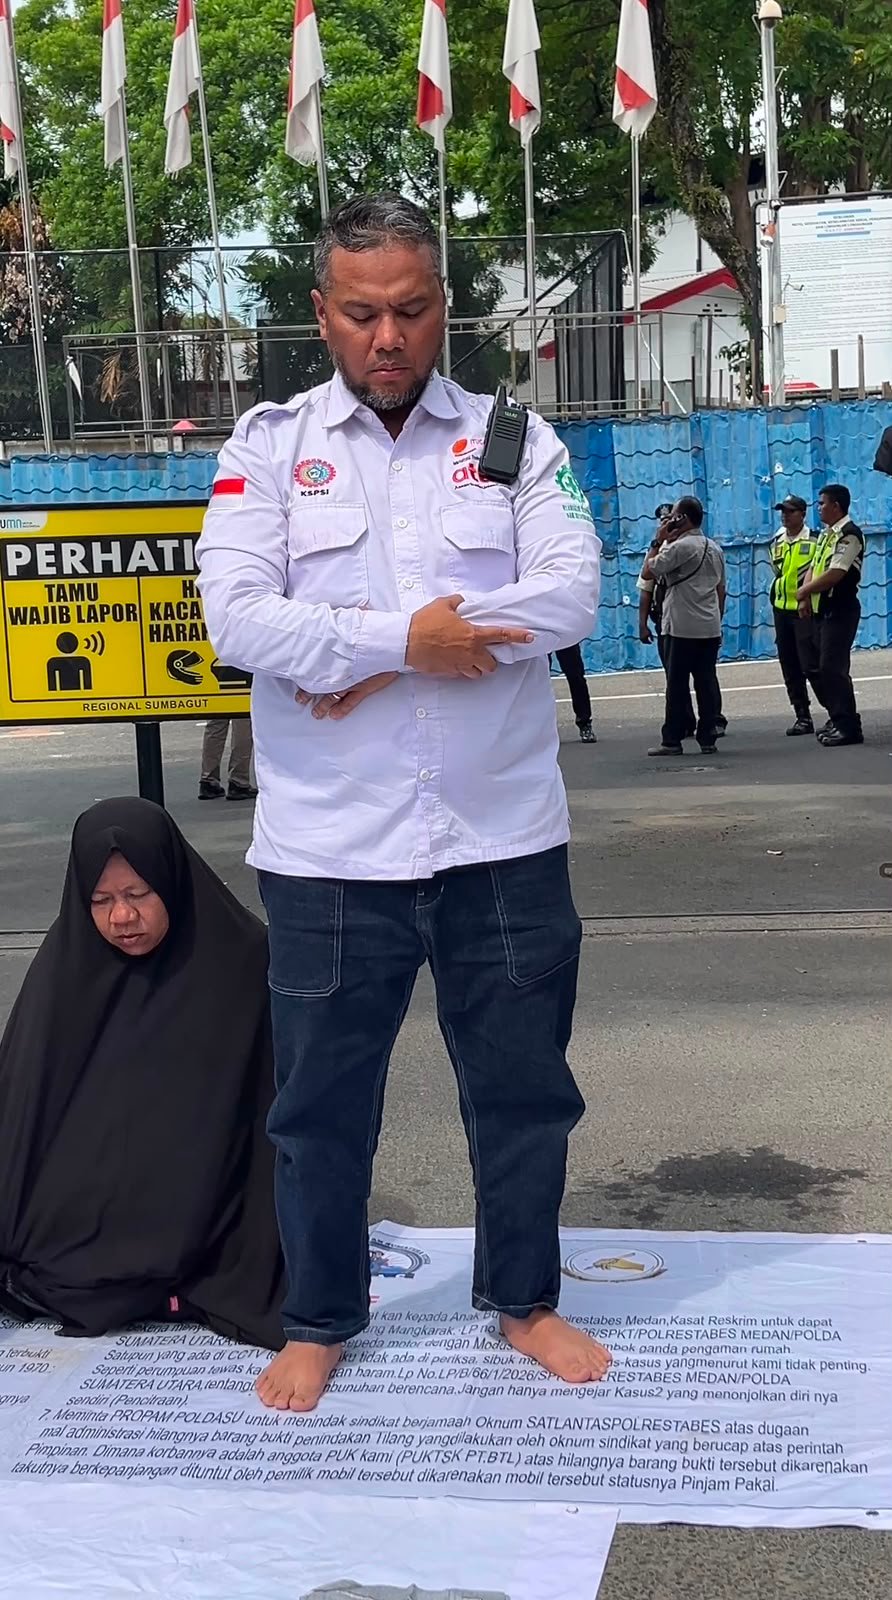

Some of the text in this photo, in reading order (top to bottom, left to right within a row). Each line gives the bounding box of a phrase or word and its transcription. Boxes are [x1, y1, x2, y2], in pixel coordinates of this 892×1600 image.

[301, 489, 329, 497] KSPSI
[6, 539, 198, 577] PERHATI
[44, 582, 99, 602] TAMU
[8, 602, 138, 626] WAJIB LAPOR
[149, 601, 202, 621] KACA
[83, 699, 209, 712] REGIONAL SUMBAGUT
[405, 1311, 447, 1323] kepada
[450, 1311, 479, 1322] Anak
[708, 1315, 758, 1327] Reskrim
[761, 1316, 794, 1327] untuk
[798, 1317, 833, 1329] dapat
[480, 1324, 496, 1333] no
[740, 1330, 842, 1342] MEDAN/POLDA
[6, 1348, 53, 1359] terbukti
[116, 1334, 187, 1348] SUMATERA
[388, 1339, 422, 1349] motor
[425, 1338, 470, 1351] dengan
[472, 1337, 514, 1351] Modus
[639, 1344, 678, 1354] ganda
[681, 1344, 747, 1356] pengaman
[104, 1349, 154, 1362] Satupun
[153, 1350, 186, 1363] yang
[187, 1351, 212, 1361] ada
[213, 1350, 225, 1361] di
[228, 1349, 265, 1361] CCTV
[360, 1351, 387, 1363] tidak
[391, 1353, 414, 1363] ada
[417, 1352, 429, 1363] di
[483, 1354, 516, 1366] sibuk
[751, 1358, 782, 1370] kami
[785, 1359, 816, 1371] tidak
[819, 1360, 871, 1374] penting.
[92, 1363, 137, 1377] Seperti
[136, 1364, 205, 1378] perumpuan
[207, 1362, 245, 1374] tewas
[685, 1372, 791, 1385] MEDAN/POLDA
[66, 1394, 109, 1406] sendiri
[80, 1378, 154, 1390] SUMATERA
[507, 1385, 547, 1398] hanya
[550, 1386, 611, 1399] mengejar
[614, 1387, 663, 1398] Kasus2
[665, 1388, 698, 1401] yang
[702, 1389, 786, 1403] menonjolkan
[789, 1390, 811, 1402] diri
[814, 1392, 839, 1405] nya
[38, 1408, 809, 1438] 7. Meminta PROPAM POLDASU untuk menindak sindikat berjamaah Oknum SATLANTASPOLRESTABES atas dugaan
[39, 1425, 64, 1438] mal
[65, 1425, 145, 1440] administrasi
[145, 1427, 209, 1445] hilangnya
[211, 1428, 258, 1446] barang
[259, 1431, 294, 1445] bukti
[293, 1431, 371, 1447] penindakan
[376, 1431, 415, 1447] Tilang
[516, 1433, 545, 1447] oleh
[549, 1434, 595, 1448] oknum
[598, 1434, 651, 1450] sindikat
[655, 1437, 688, 1454] yang
[692, 1437, 749, 1455] berucap
[752, 1440, 783, 1453] atas
[787, 1441, 843, 1456] perintah
[25, 1443, 88, 1457] Pimpinan.
[93, 1443, 145, 1458] Dimana
[149, 1445, 216, 1460] korbannya
[218, 1449, 264, 1462] adalah
[267, 1450, 321, 1465] anggota
[325, 1449, 359, 1462] PUK
[360, 1449, 393, 1463] kami
[465, 1450, 522, 1467] PT.BTL)
[524, 1453, 554, 1466] atas
[557, 1453, 624, 1471] hilangnya
[628, 1454, 678, 1471] barang
[682, 1456, 715, 1471] bukti
[719, 1458, 777, 1473] tersebut
[781, 1459, 868, 1474] dikarenakan
[11, 1460, 779, 1494] takutnya berkepanjangan dituntut oleh pemilik mobil tersebut dikarenakan mobil tersebut statusnya Pinjam Pakai.
